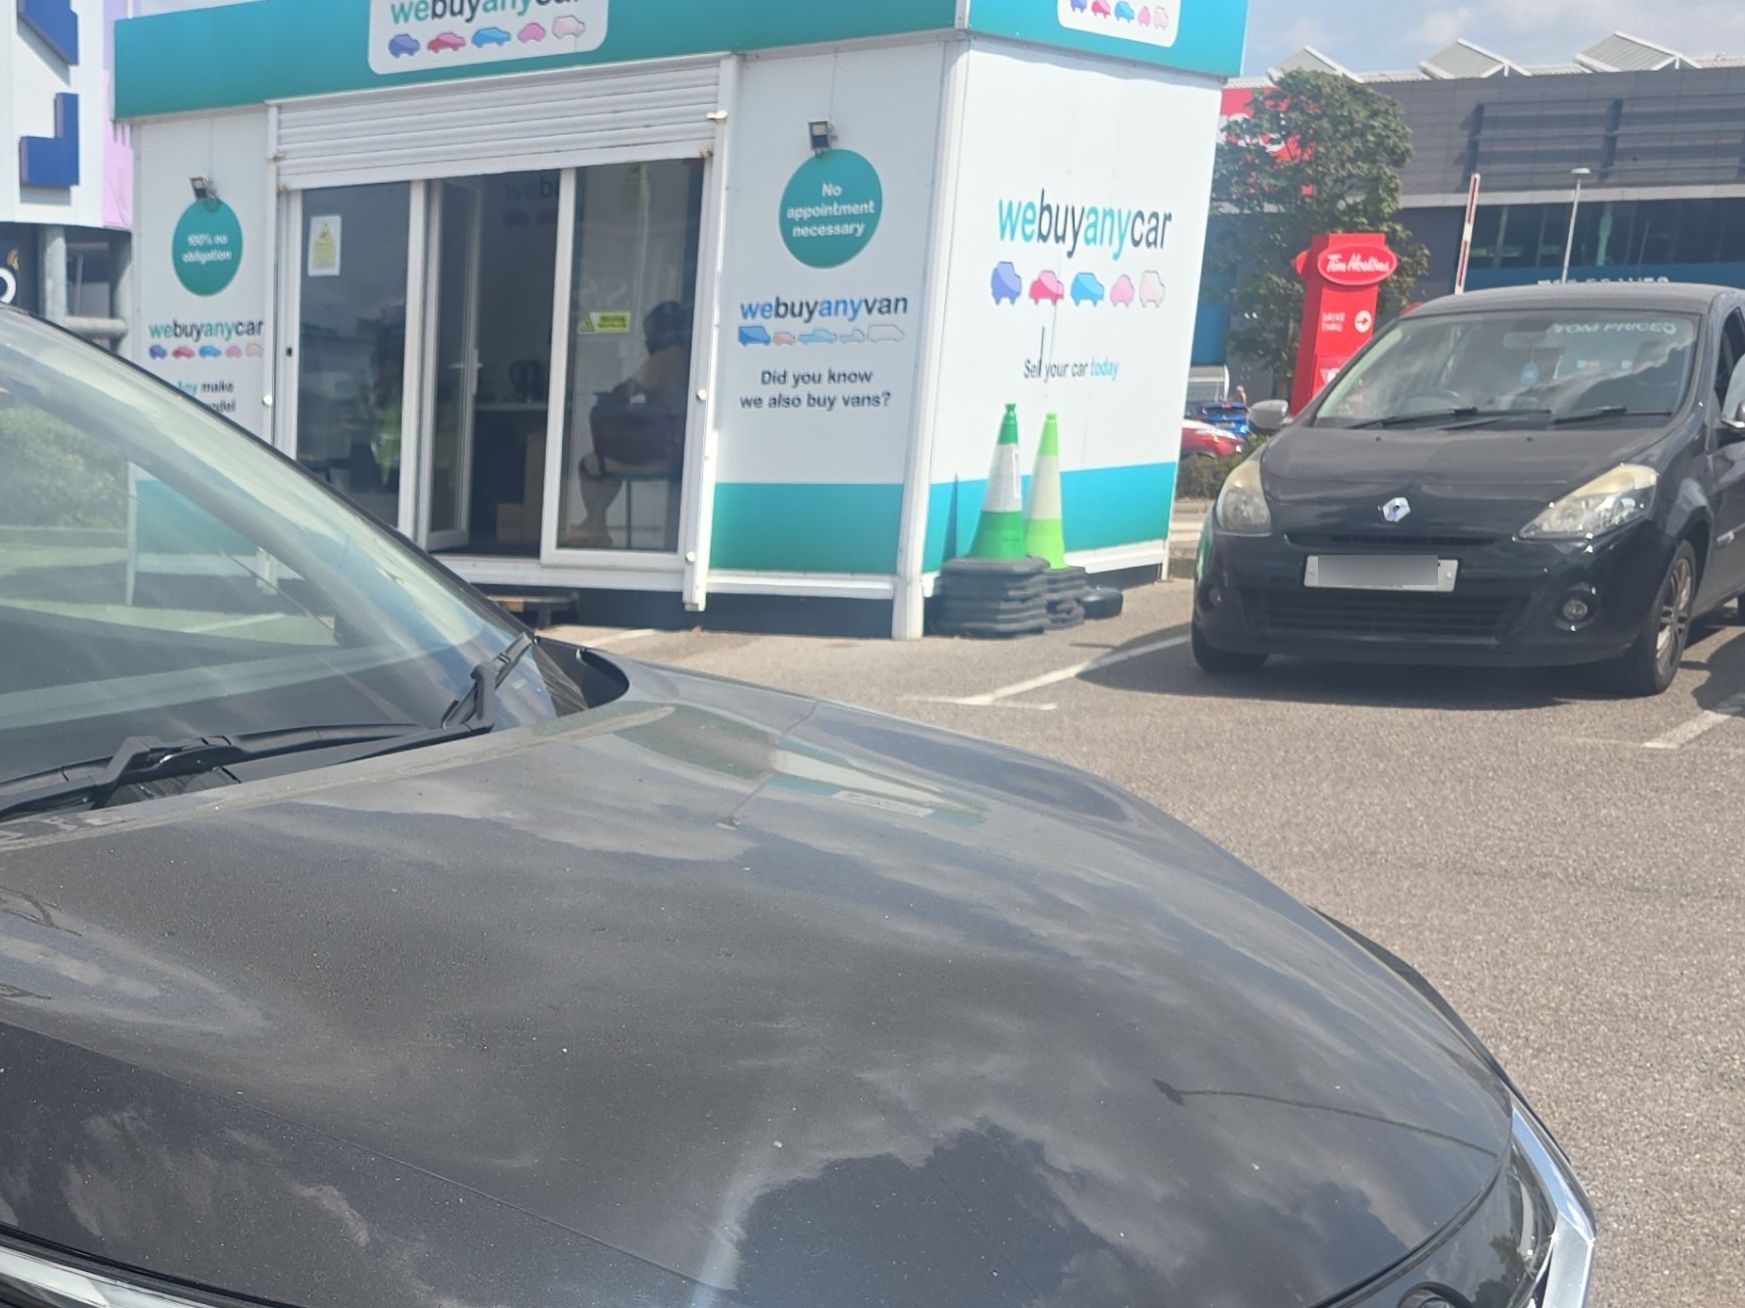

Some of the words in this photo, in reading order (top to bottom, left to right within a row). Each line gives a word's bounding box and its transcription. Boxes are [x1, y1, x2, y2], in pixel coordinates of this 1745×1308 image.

[822, 183, 843, 197] No
[786, 200, 875, 220] appointment
[792, 221, 865, 237] necessary
[998, 188, 1172, 260] webuyanycar
[1326, 253, 1347, 272] Tim
[740, 297, 909, 323] webuyanyvan
[149, 319, 264, 342] webuyanycar
[761, 369, 788, 385] Did
[792, 371, 822, 388] you
[827, 368, 873, 384] know
[1044, 359, 1069, 383] your
[1071, 361, 1088, 377] car
[1090, 356, 1120, 381] today
[200, 378, 235, 394] make
[740, 395, 764, 409] we
[768, 391, 802, 408] also
[806, 391, 838, 410] buy
[841, 390, 892, 407] vans?
